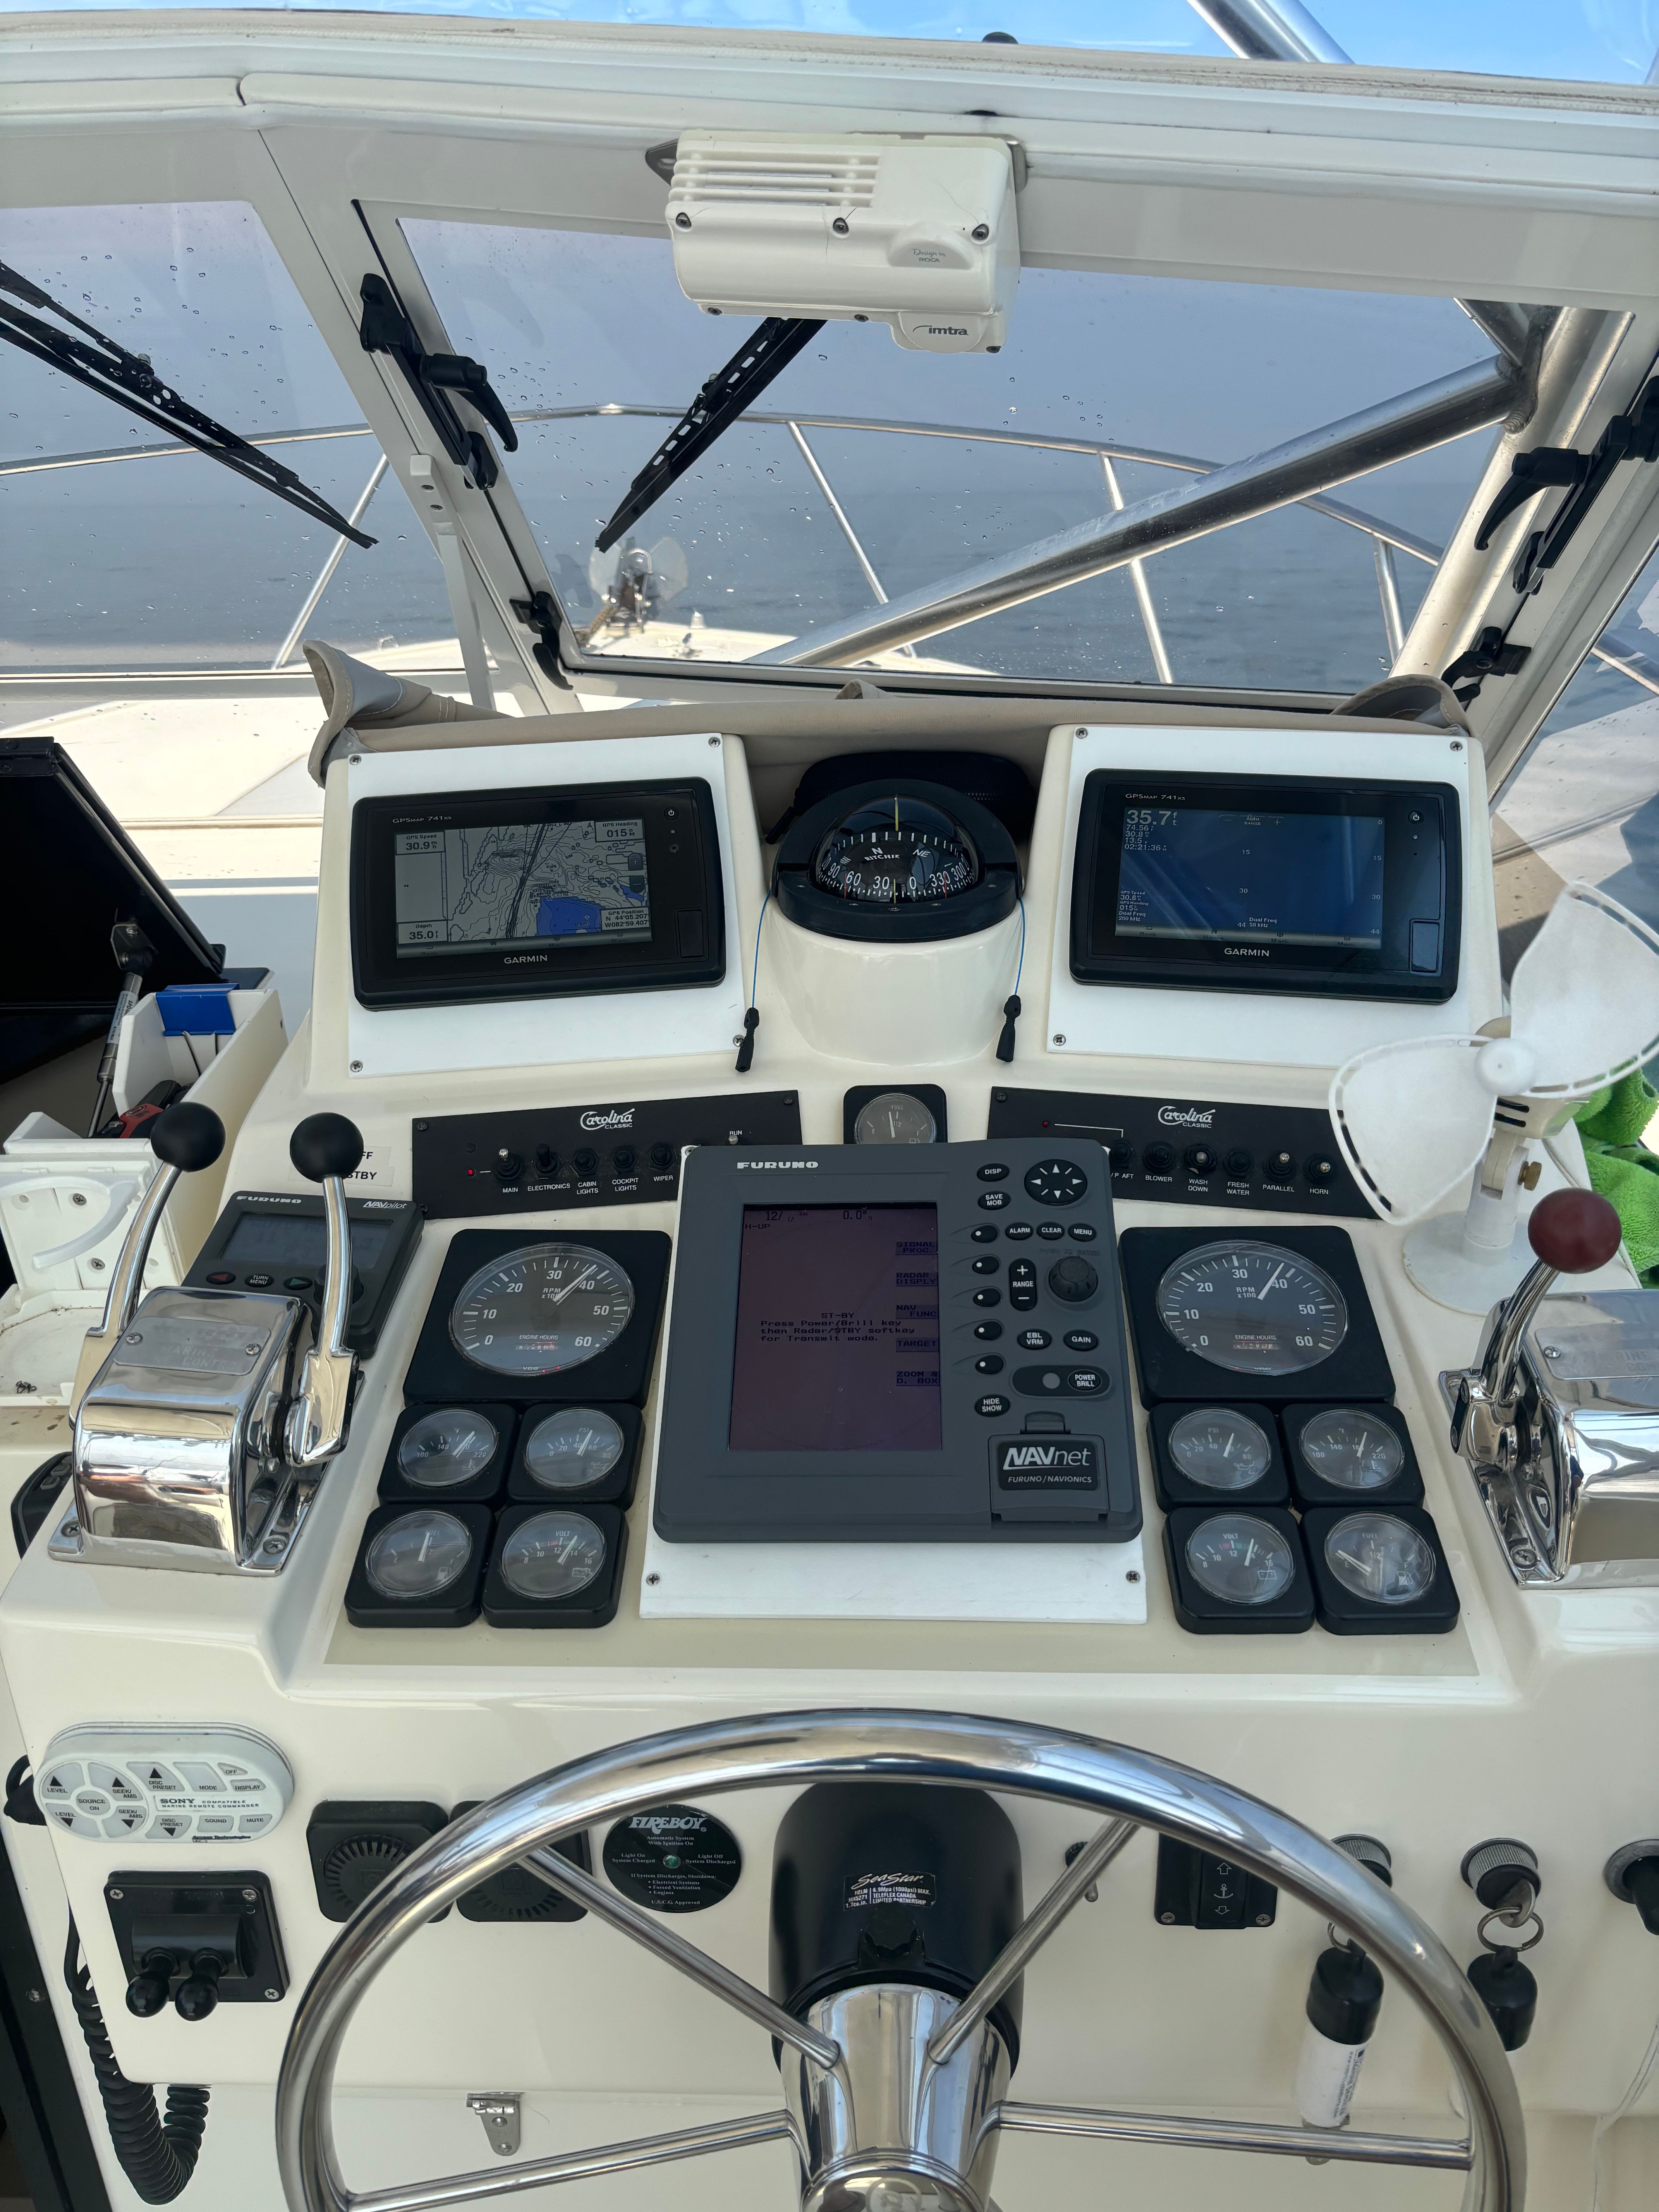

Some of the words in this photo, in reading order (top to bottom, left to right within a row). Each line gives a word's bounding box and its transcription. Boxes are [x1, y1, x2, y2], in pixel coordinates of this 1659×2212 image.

[912, 249, 937, 257] Design
[929, 327, 969, 335] imtra
[1127, 810, 1171, 825] 35.7
[607, 829, 627, 837] 015
[406, 842, 430, 850] 30.9
[913, 849, 930, 858] NE
[951, 862, 966, 881] 300
[846, 871, 861, 886] 60
[873, 876, 890, 889] 30
[909, 877, 917, 889] 0
[930, 871, 950, 887] 330
[409, 931, 434, 940] 35.0
[1224, 948, 1269, 957] GARMIN
[504, 955, 547, 964] GARMIN
[580, 1108, 635, 1130] Carolina
[1158, 1106, 1216, 1125] Carolina
[527, 1183, 570, 1192] ELECTRONICS
[1263, 1184, 1295, 1192] PARALLEL
[547, 1271, 562, 1279] 30
[1232, 1269, 1248, 1278] 30
[507, 1283, 523, 1293] 20
[1197, 1283, 1213, 1292] 20
[593, 1306, 609, 1315] 50
[1299, 1304, 1315, 1314] 50
[483, 1309, 497, 1319] 10
[1184, 1309, 1199, 1319] 10
[484, 1335, 493, 1344] 0
[575, 1337, 592, 1346] 60
[1200, 1336, 1208, 1345] 0
[1296, 1336, 1313, 1346] 60
[1003, 1447, 1091, 1470] NAVnet
[628, 1817, 707, 1834] FIREBOY
[851, 1873, 924, 1889] SeaStar
